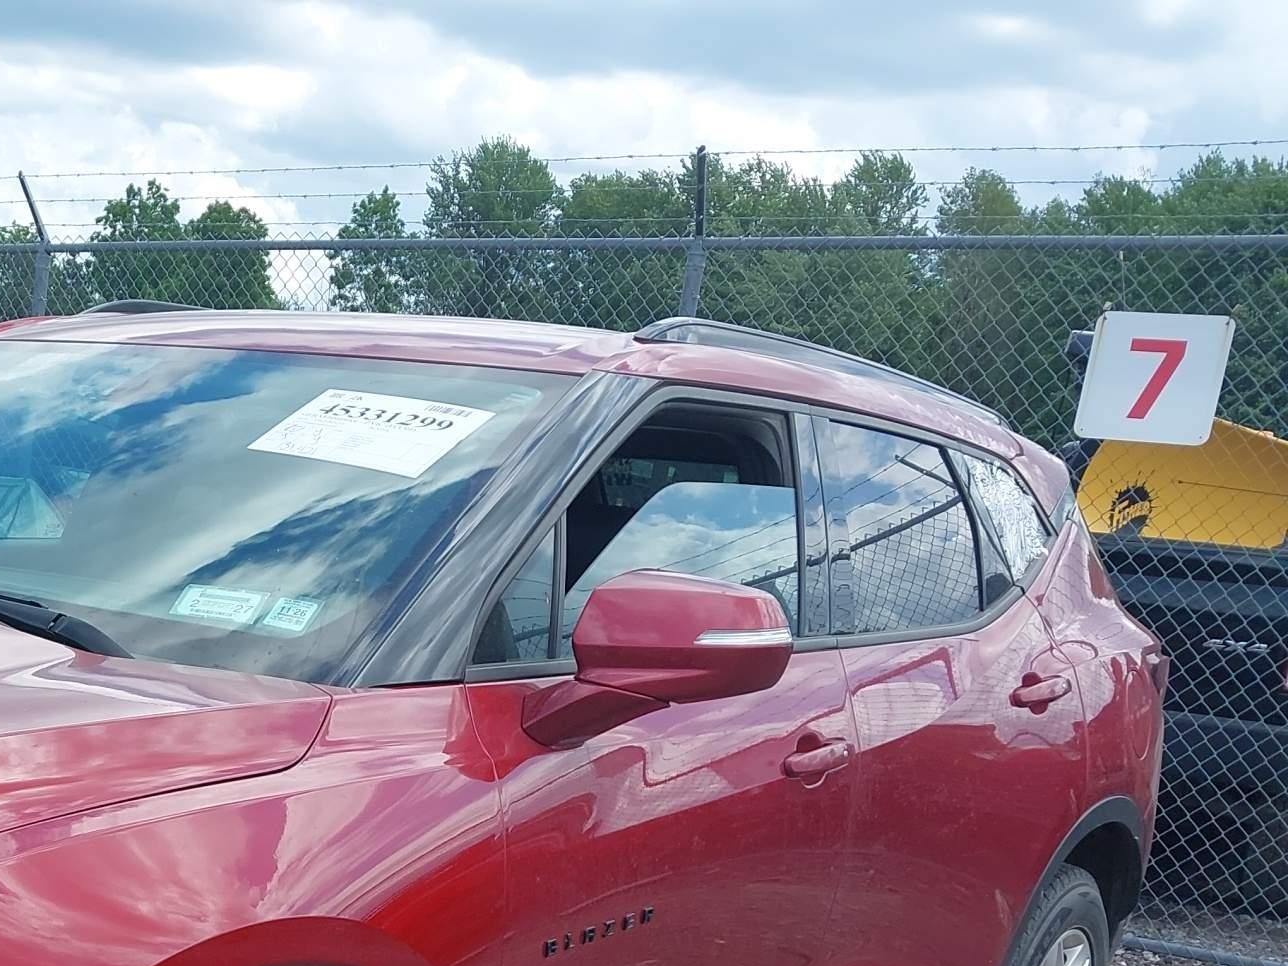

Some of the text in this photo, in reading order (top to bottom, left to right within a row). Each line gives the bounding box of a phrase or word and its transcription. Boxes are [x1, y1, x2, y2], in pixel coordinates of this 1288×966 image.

[1127, 338, 1188, 420] 7
[320, 403, 454, 431] 45331299
[543, 906, 654, 958] BLAZER
